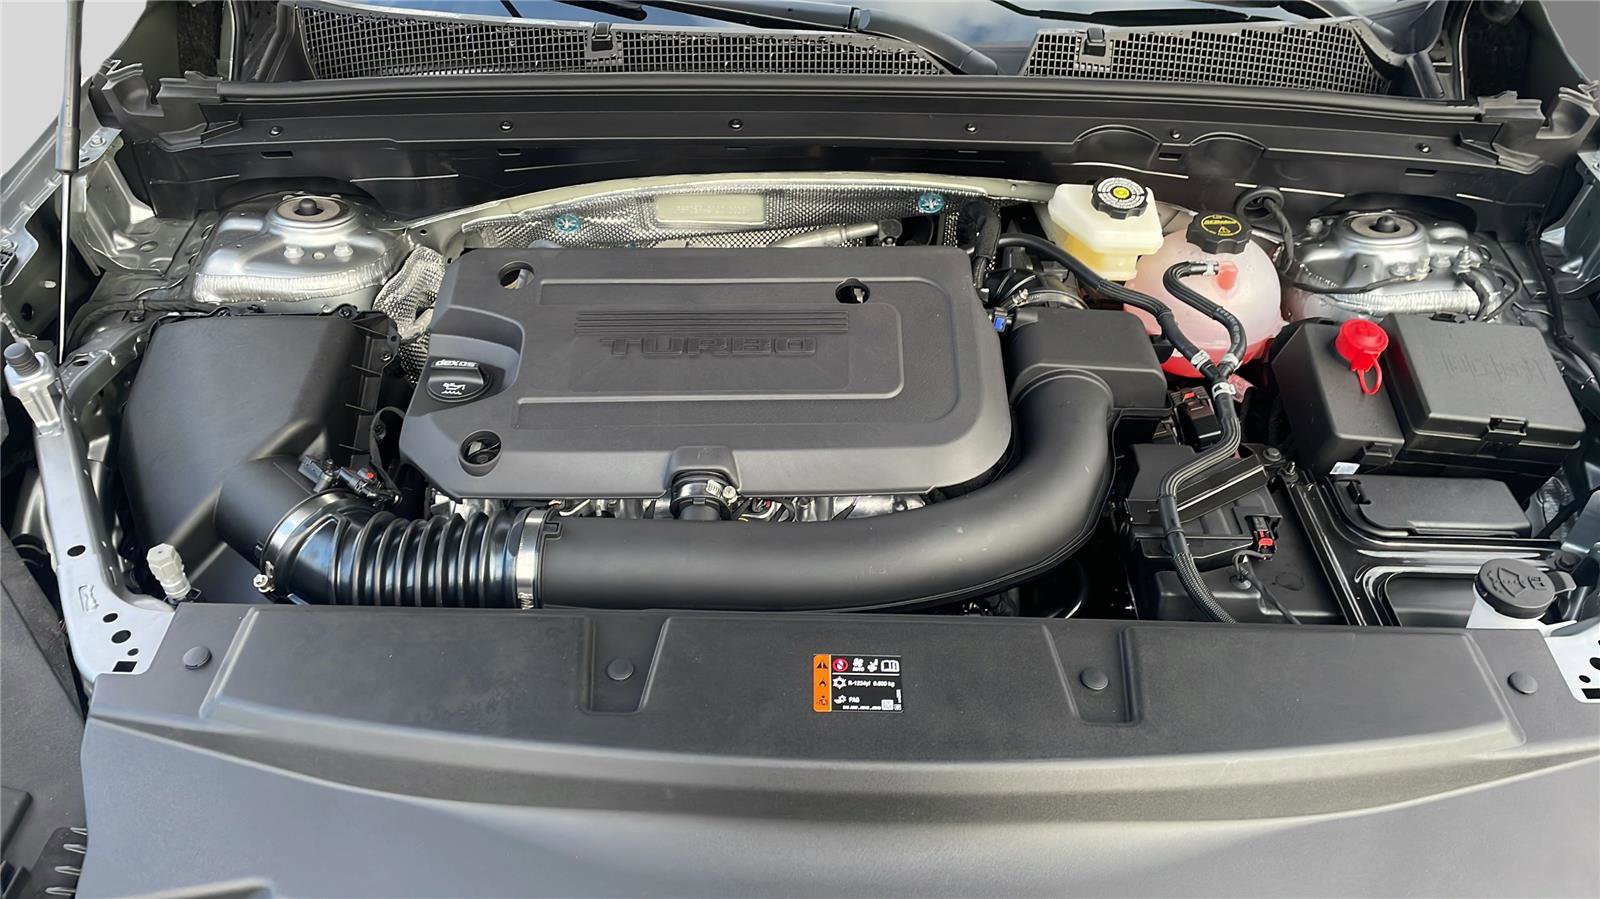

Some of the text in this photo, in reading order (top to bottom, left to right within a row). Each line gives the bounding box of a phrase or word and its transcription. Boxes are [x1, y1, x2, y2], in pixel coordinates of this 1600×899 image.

[600, 336, 818, 358] TURBO
[435, 359, 477, 367] dexos
[888, 680, 896, 688] kg
